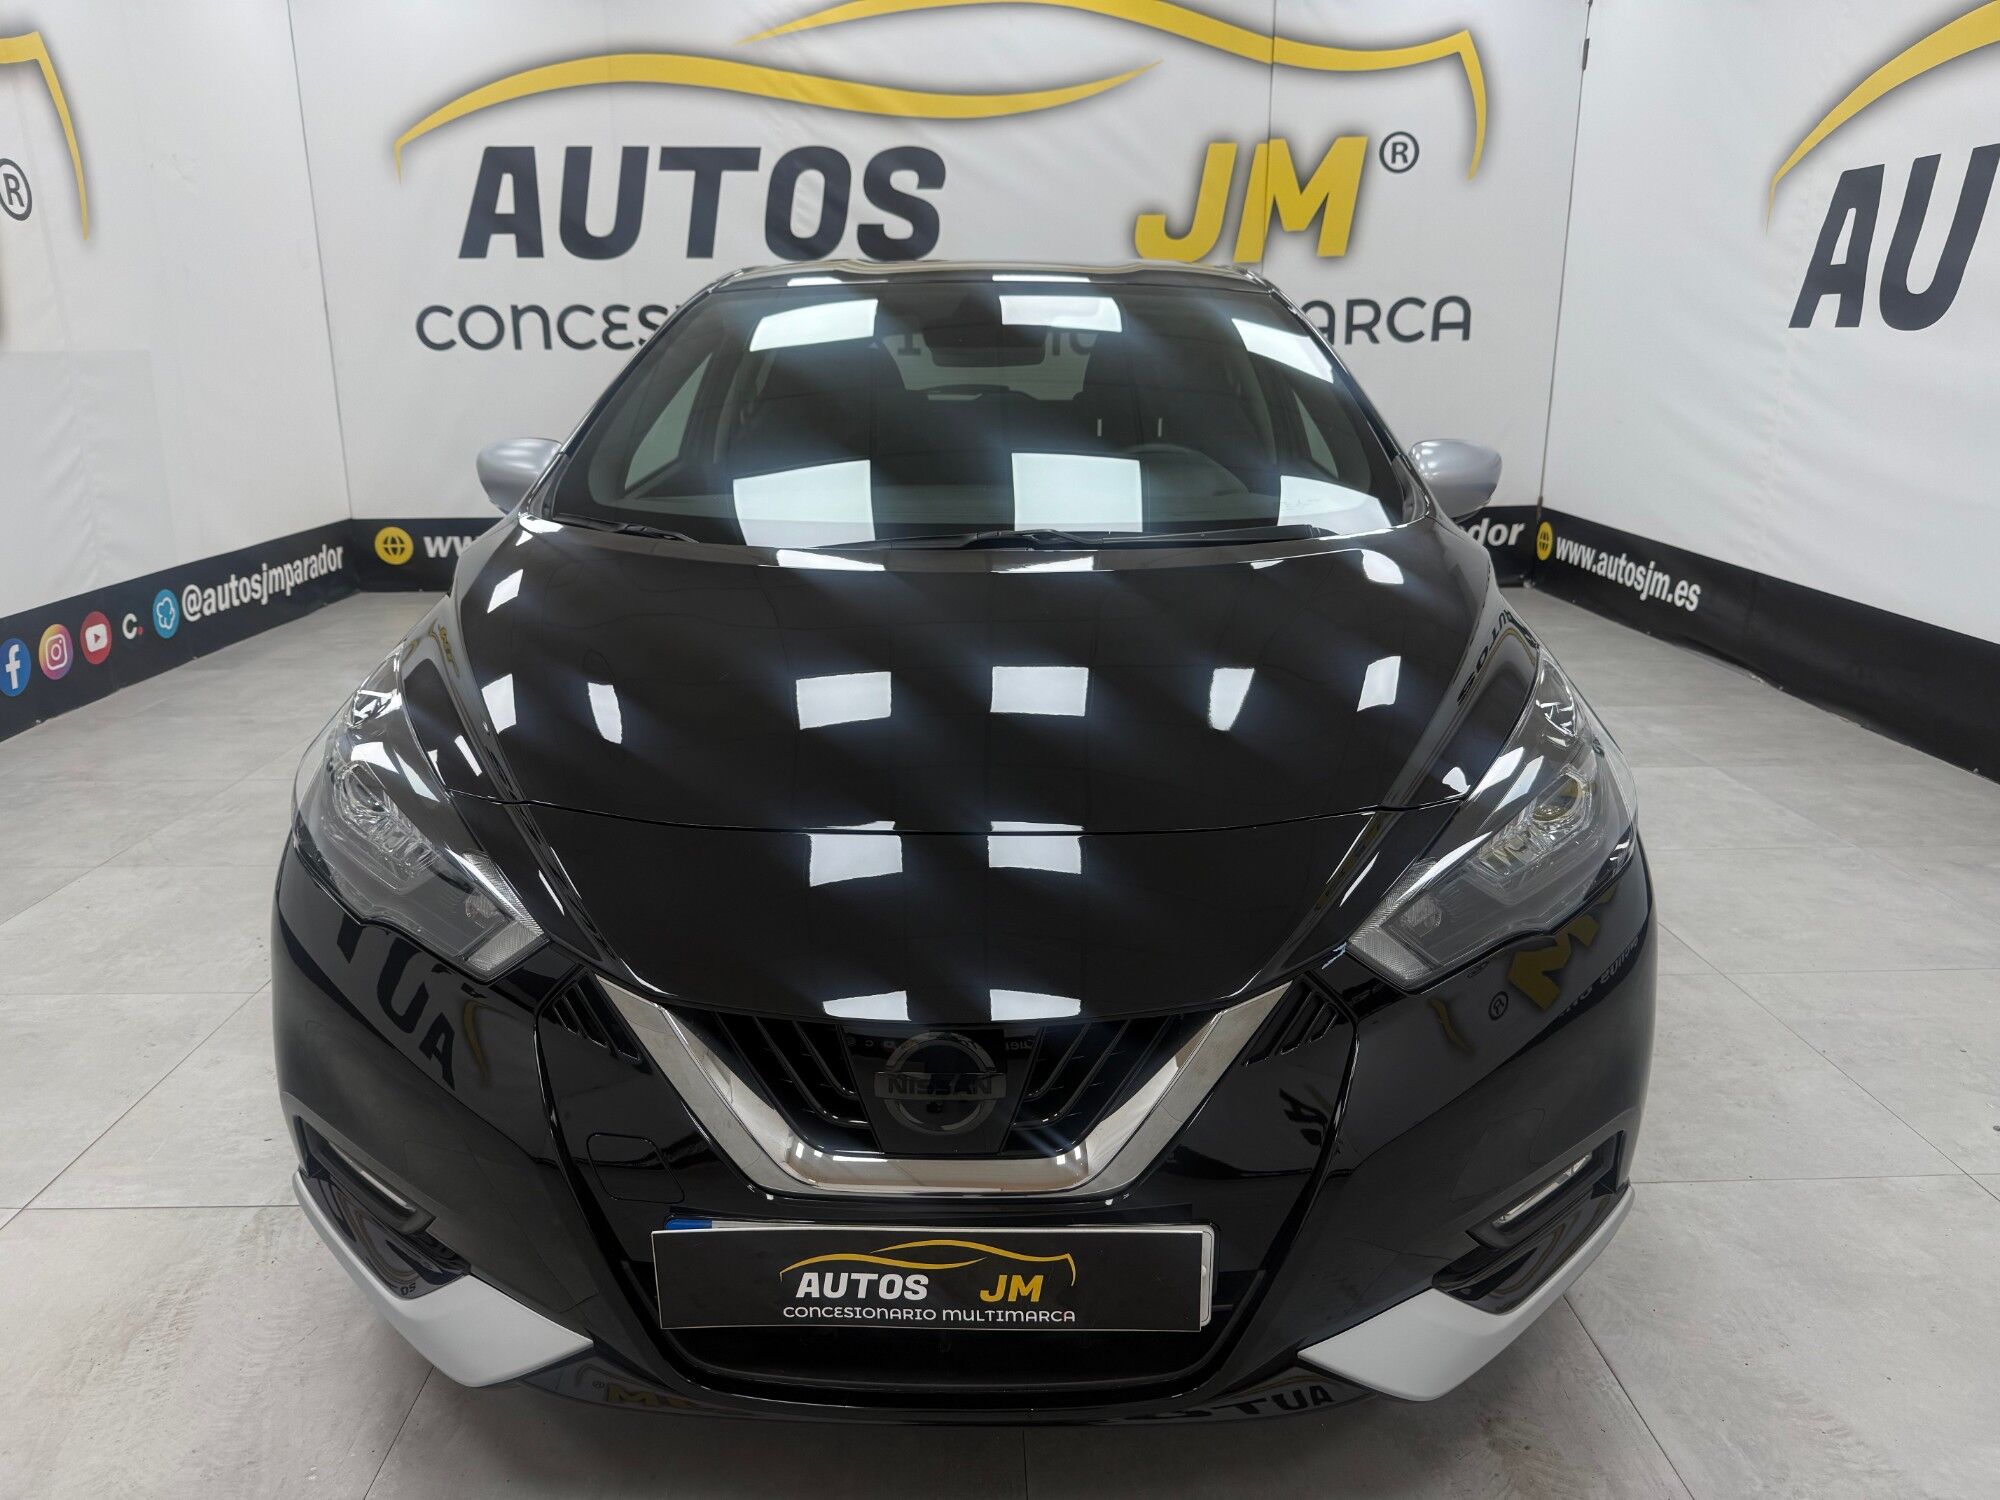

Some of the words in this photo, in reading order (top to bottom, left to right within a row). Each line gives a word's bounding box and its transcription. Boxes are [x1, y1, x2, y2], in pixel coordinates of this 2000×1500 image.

[458, 146, 946, 261] AUTOS
[1134, 136, 1368, 262] JM
[416, 304, 680, 350] CONCES
[1459, 518, 1526, 546] dor
[181, 544, 344, 622] @autosjmparador
[1556, 536, 1700, 612] www.autosjm.es
[796, 1272, 929, 1300] AUTOS
[980, 1274, 1044, 1302] JM
[783, 1306, 937, 1321] CONCESIONARIO
[942, 1308, 1076, 1322] MULTIMARCA
